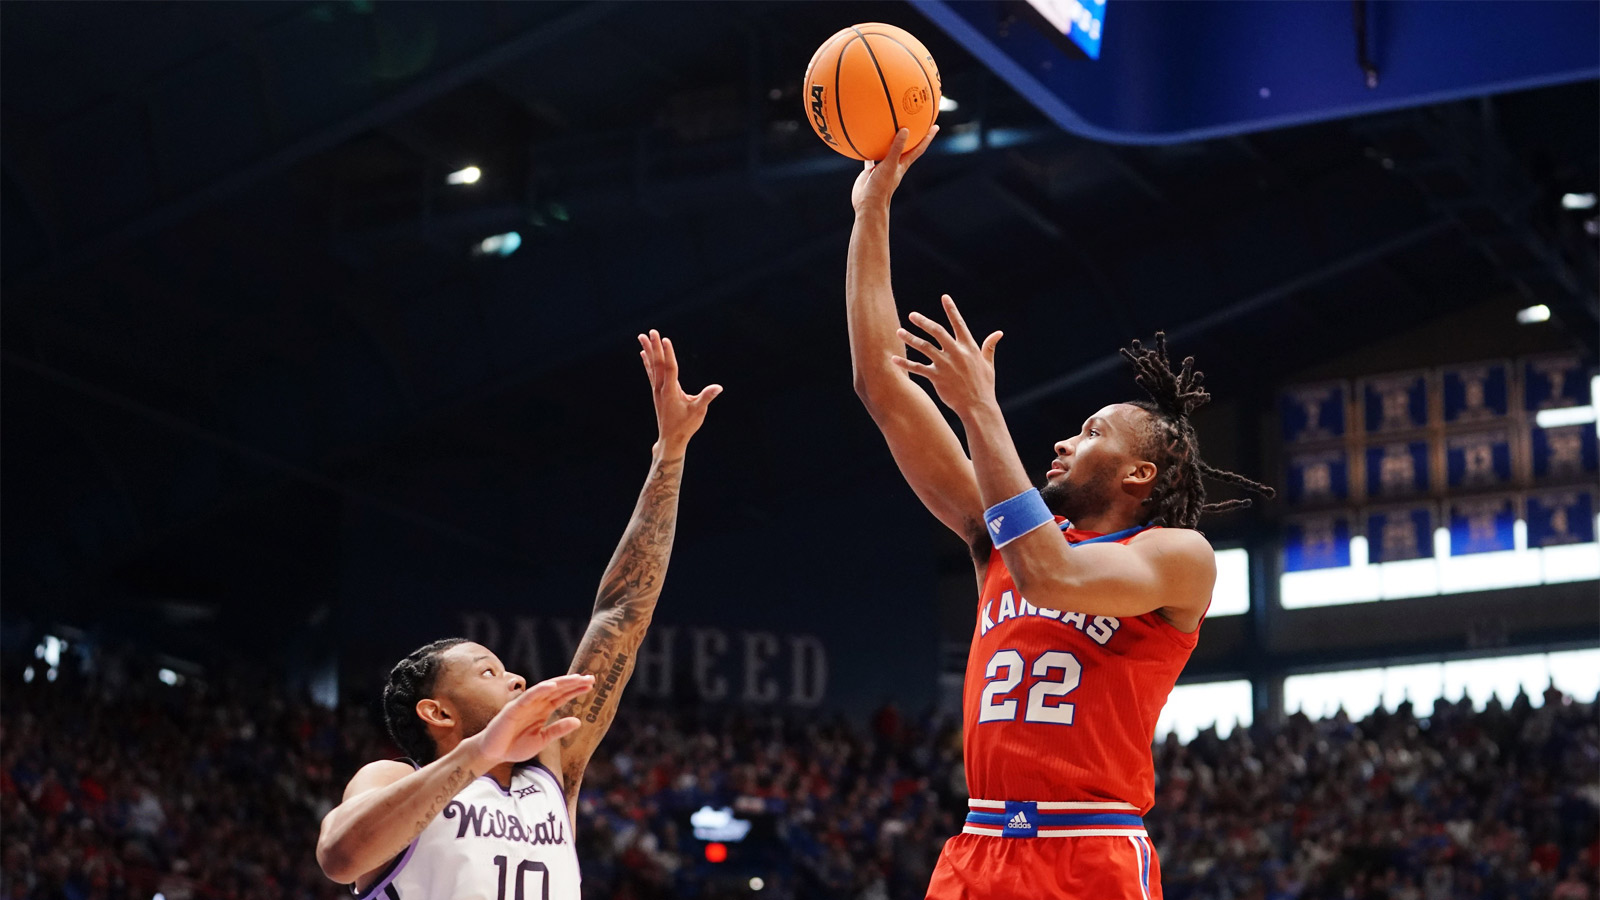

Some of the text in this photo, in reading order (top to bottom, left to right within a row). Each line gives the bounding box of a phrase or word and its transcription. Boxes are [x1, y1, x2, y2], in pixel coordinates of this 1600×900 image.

[811, 84, 838, 147] NCAA
[586, 652, 628, 724] CARPEDIEM
[635, 624, 830, 708] HEED
[979, 649, 1082, 726] 22
[1008, 821, 1031, 829] adidas
[493, 854, 549, 900] 10
